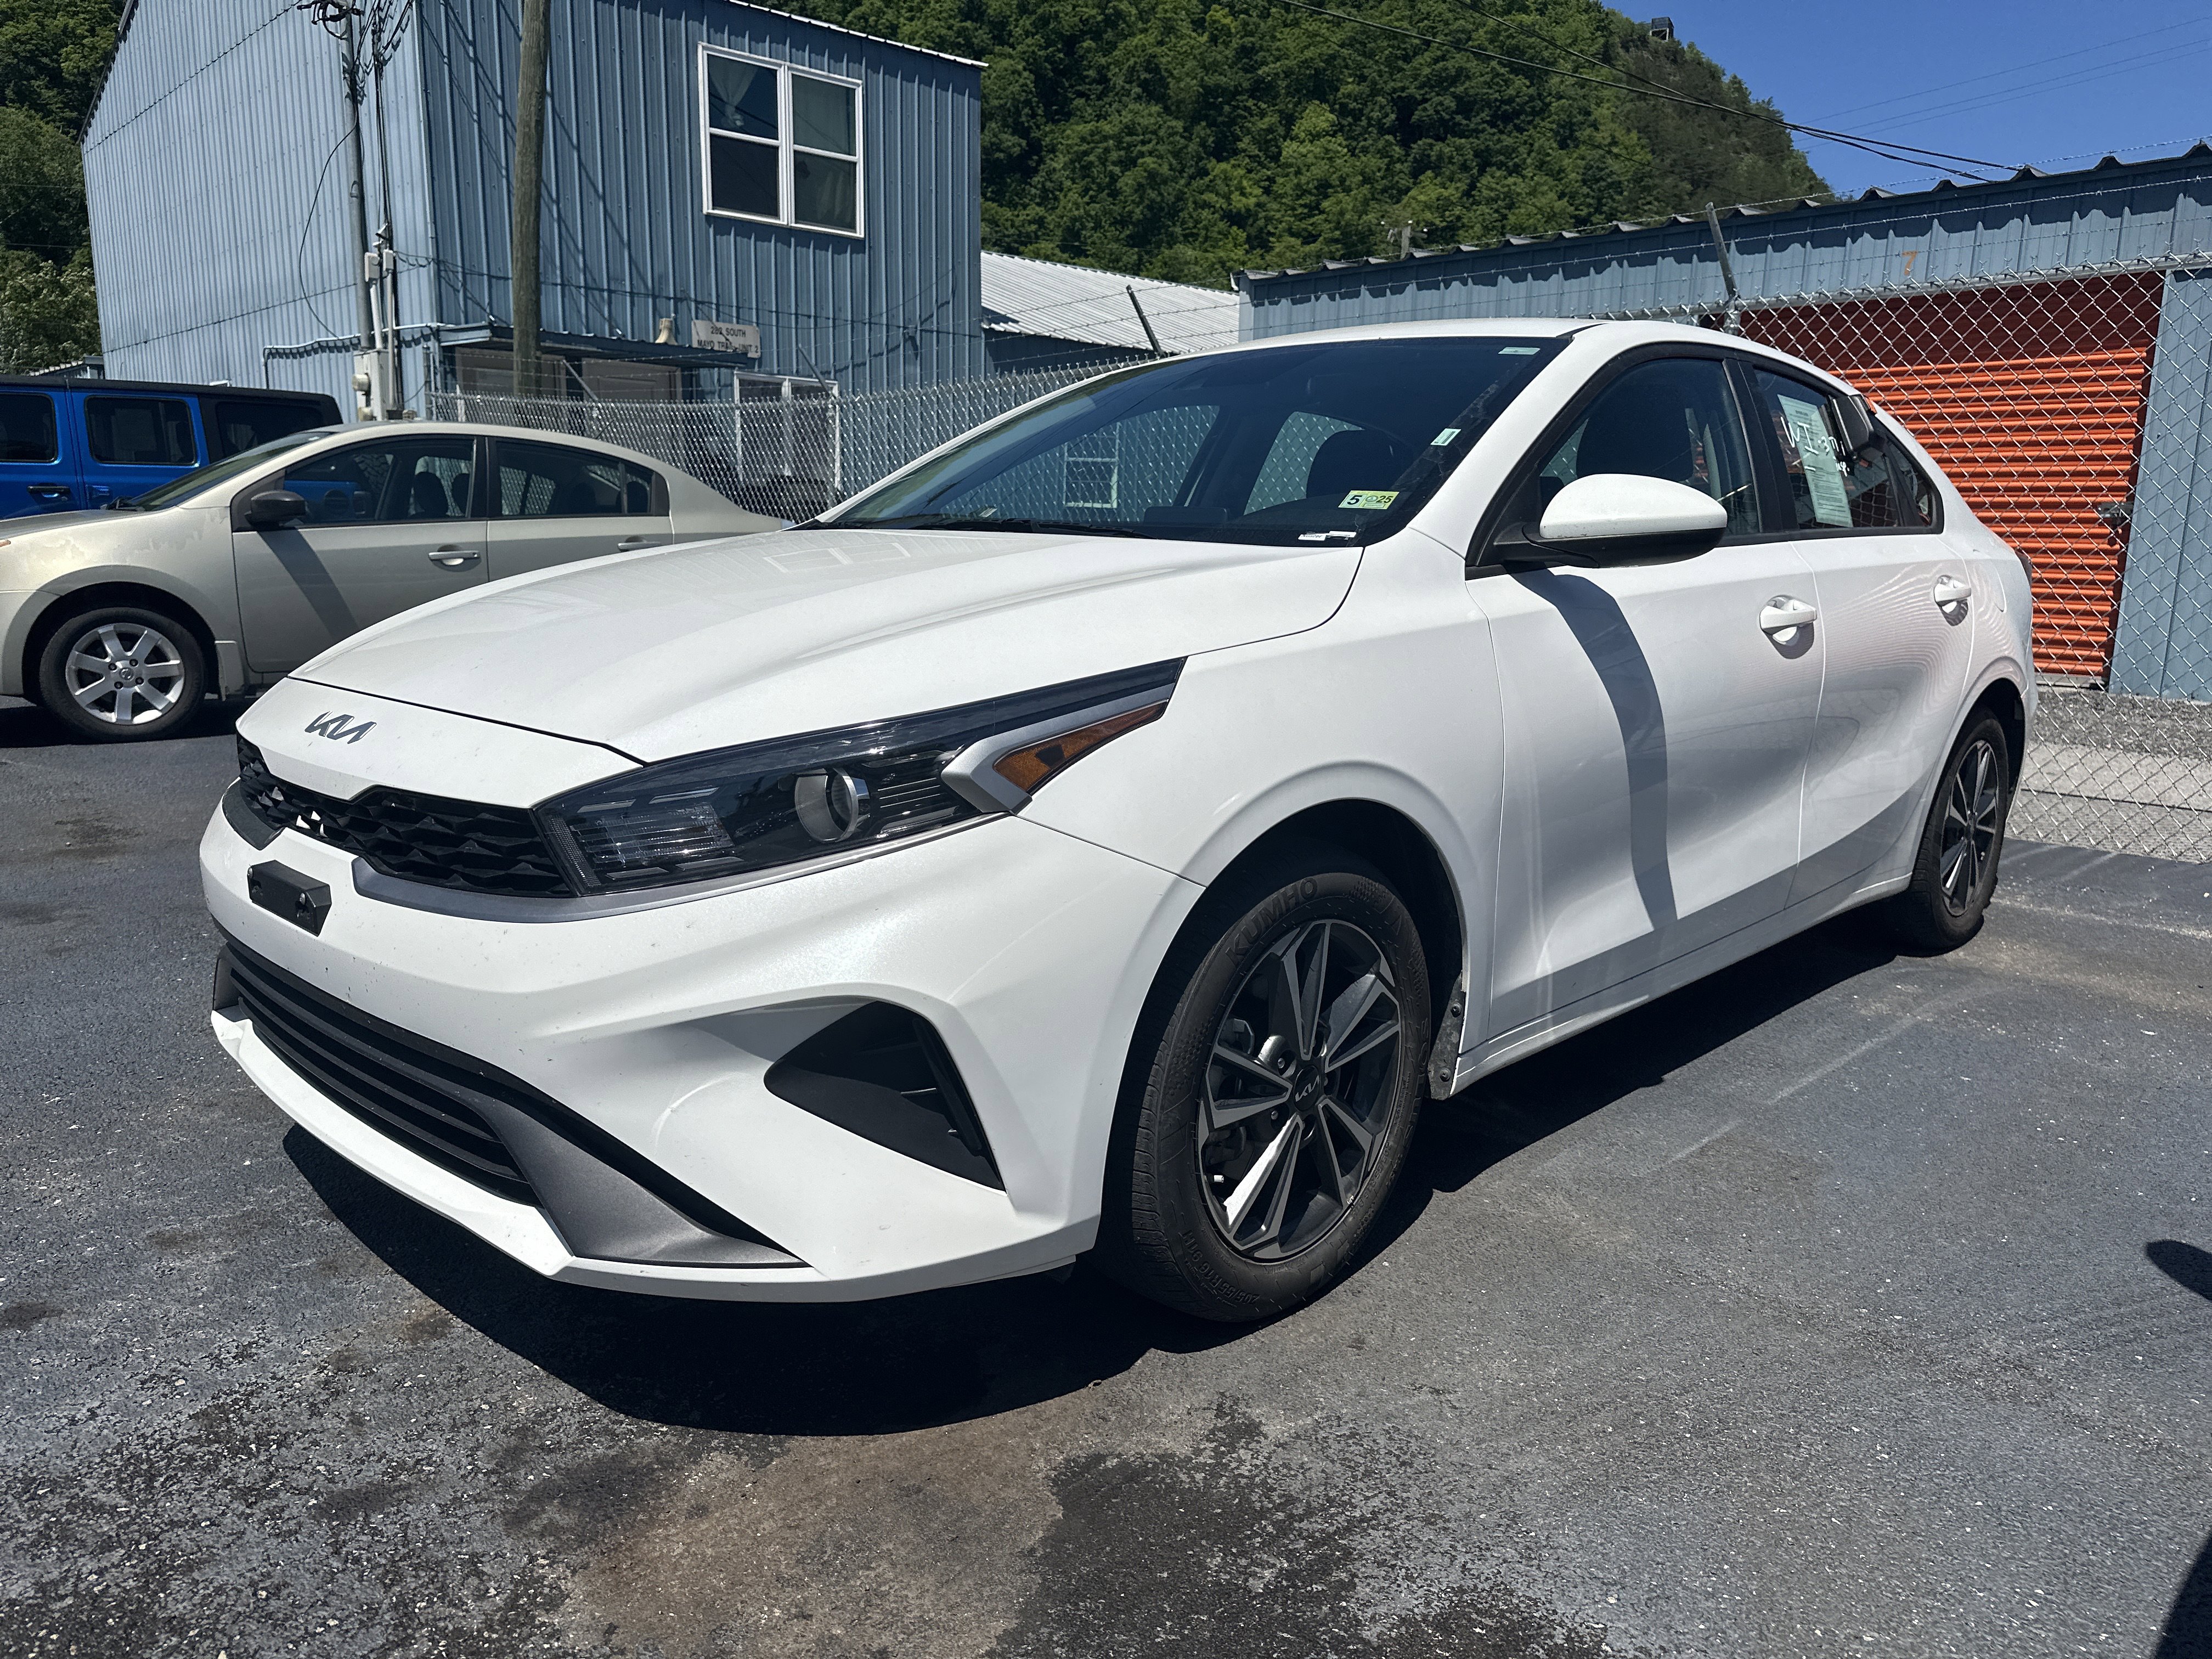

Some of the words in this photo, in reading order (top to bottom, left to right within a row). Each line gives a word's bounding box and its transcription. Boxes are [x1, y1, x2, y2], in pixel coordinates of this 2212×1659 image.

[1901, 250, 1917, 276] 7
[697, 339, 715, 348] MAYO
[725, 328, 746, 337] SOUTH
[1347, 495, 1362, 505] 5
[304, 710, 377, 744] KIA
[1226, 877, 1317, 966] KUMHO
[1295, 1075, 1320, 1102] KIA
[1217, 1283, 1261, 1304] 205/55
